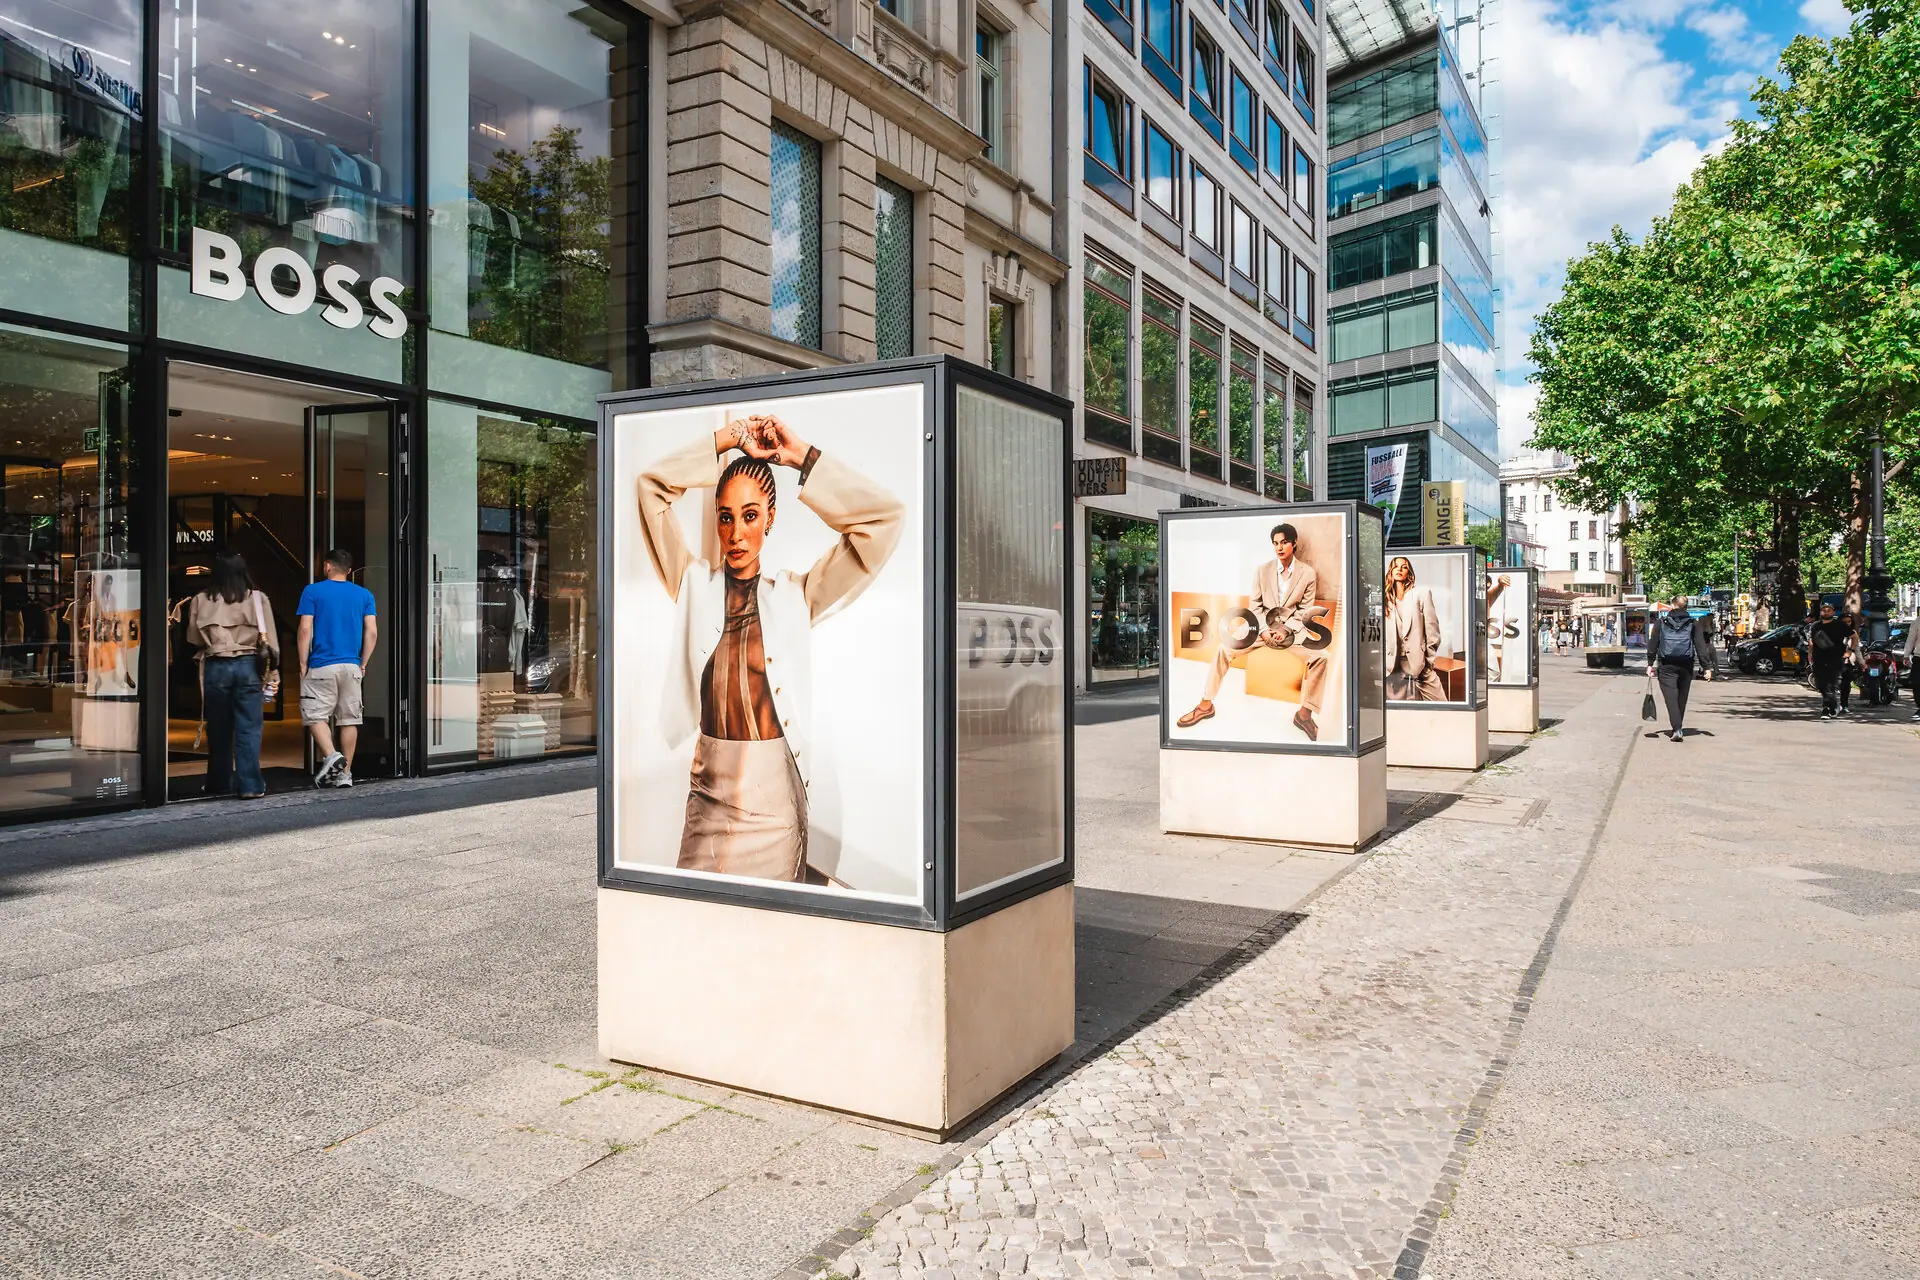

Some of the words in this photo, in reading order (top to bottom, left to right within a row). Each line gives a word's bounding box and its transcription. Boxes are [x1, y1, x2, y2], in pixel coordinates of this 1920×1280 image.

[190, 227, 408, 340] BOSS
[1078, 458, 1121, 471] URBAN
[1371, 448, 1402, 465] FUSSBALL
[1079, 469, 1122, 483] OUTFIT
[1079, 482, 1107, 496] TERS
[1181, 606, 1332, 650] BOSS
[969, 617, 1054, 668] BOSS
